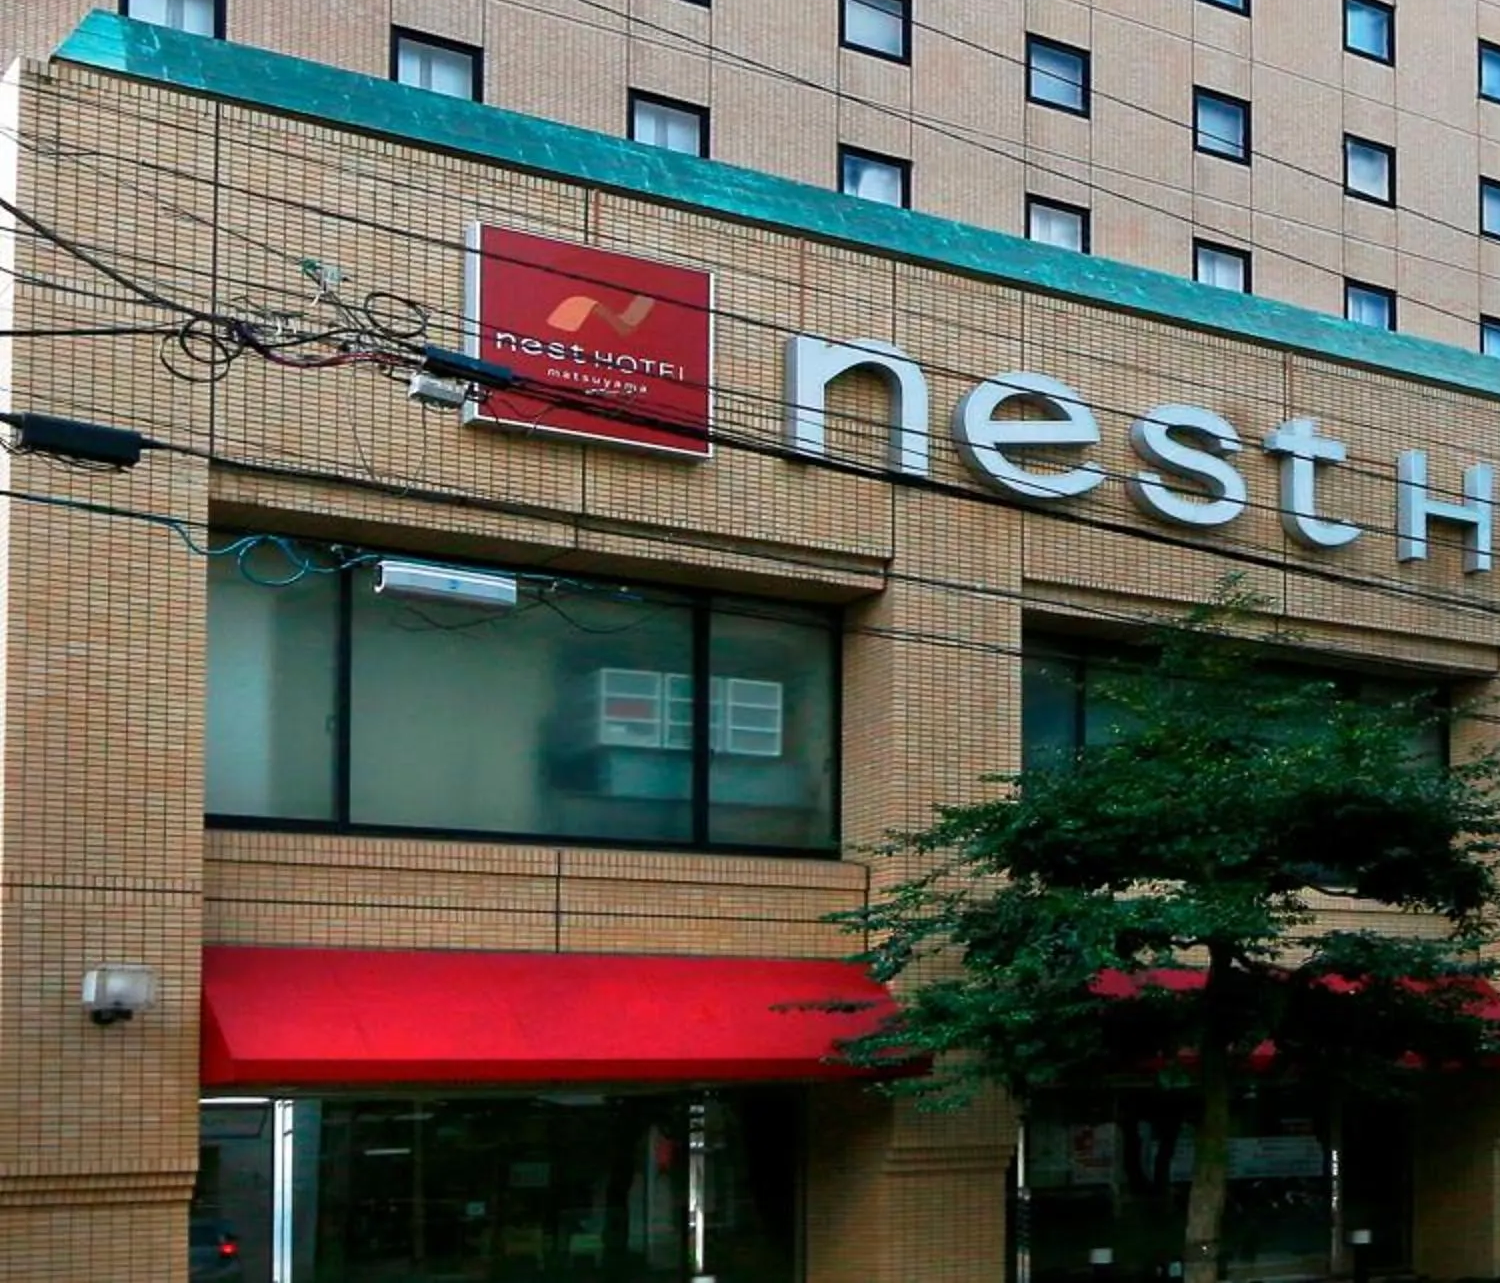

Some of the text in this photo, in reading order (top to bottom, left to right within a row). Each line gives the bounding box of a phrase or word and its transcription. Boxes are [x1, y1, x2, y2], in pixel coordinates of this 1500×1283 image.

[496, 332, 586, 365] nest
[547, 368, 648, 395] matsuyama
[784, 334, 1364, 548] nest
